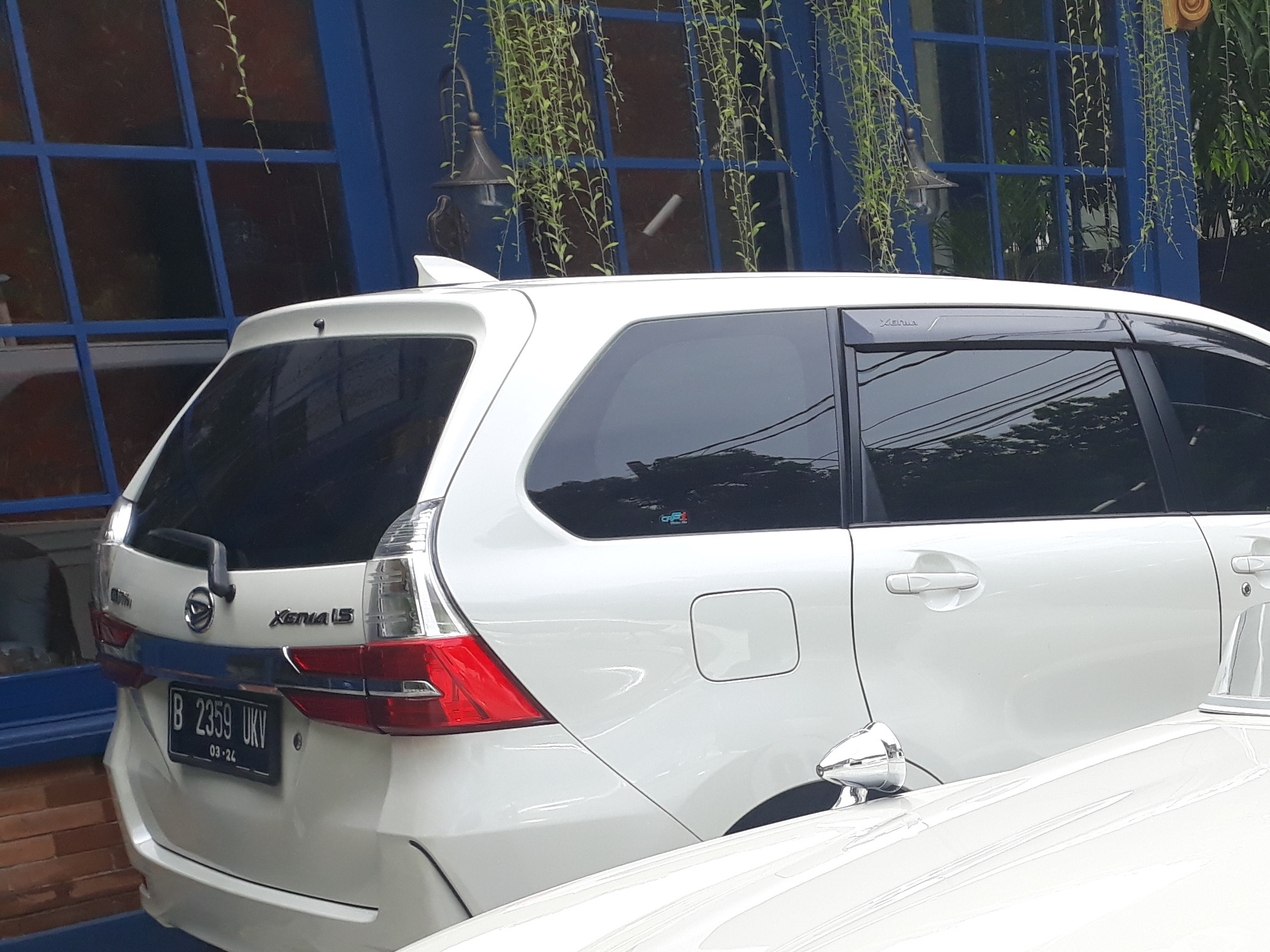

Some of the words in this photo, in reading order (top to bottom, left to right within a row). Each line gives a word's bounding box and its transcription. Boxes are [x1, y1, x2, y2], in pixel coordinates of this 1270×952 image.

[173, 692, 183, 731] B
[196, 697, 232, 739] 2359
[243, 705, 267, 749] UKV
